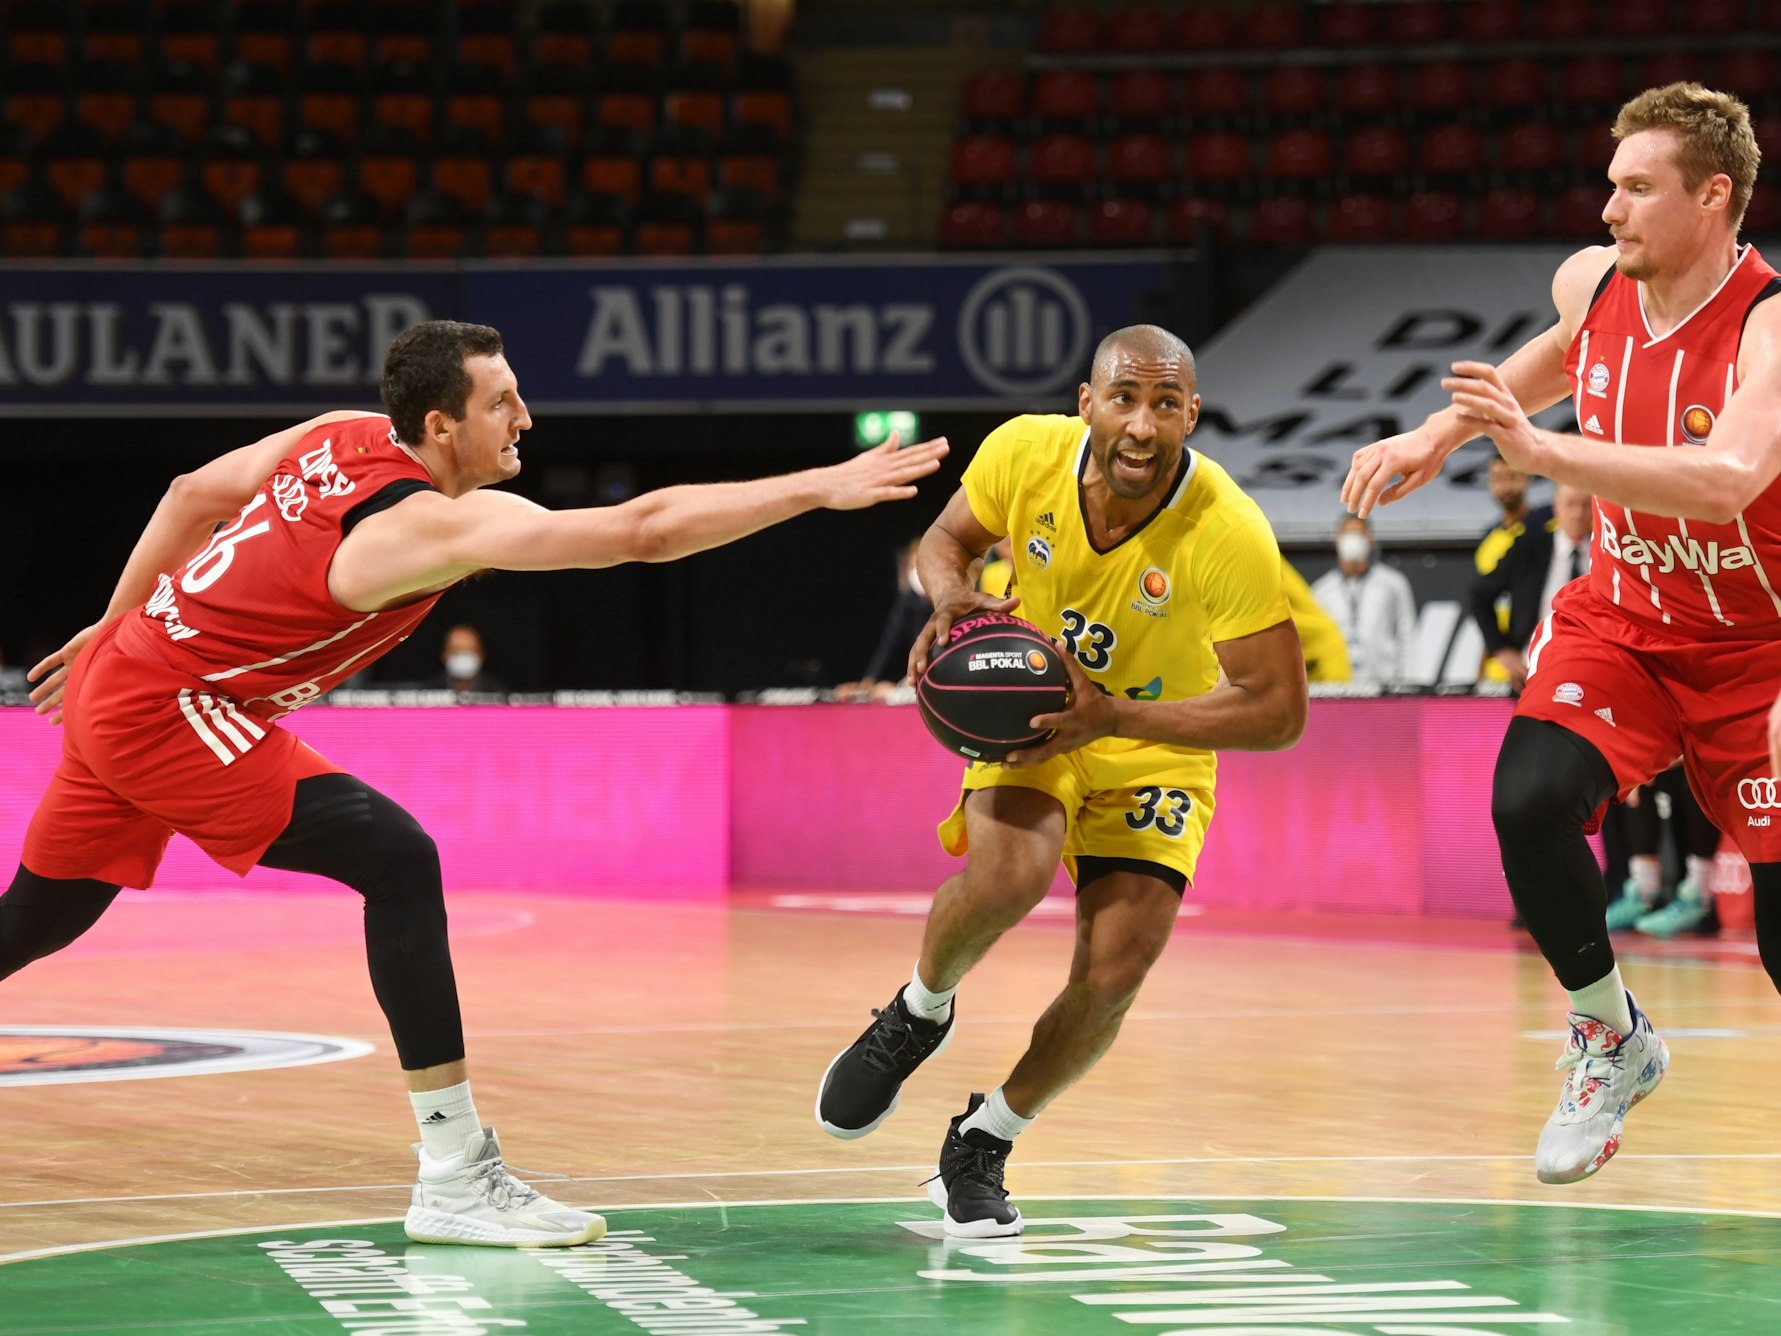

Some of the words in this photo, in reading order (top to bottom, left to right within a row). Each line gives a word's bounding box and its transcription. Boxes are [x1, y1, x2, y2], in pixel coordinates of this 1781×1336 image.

[0, 293, 432, 385] ULANER
[577, 285, 935, 375] Allianz
[1599, 509, 1755, 575] BayWa
[968, 660, 989, 672] BBL
[990, 658, 1026, 669] POKAL
[976, 652, 1004, 660] MAGENTA
[1059, 608, 1117, 672] 33
[1124, 785, 1193, 838] 33
[1747, 815, 1770, 827] Audi
[257, 1239, 475, 1298] schafft
